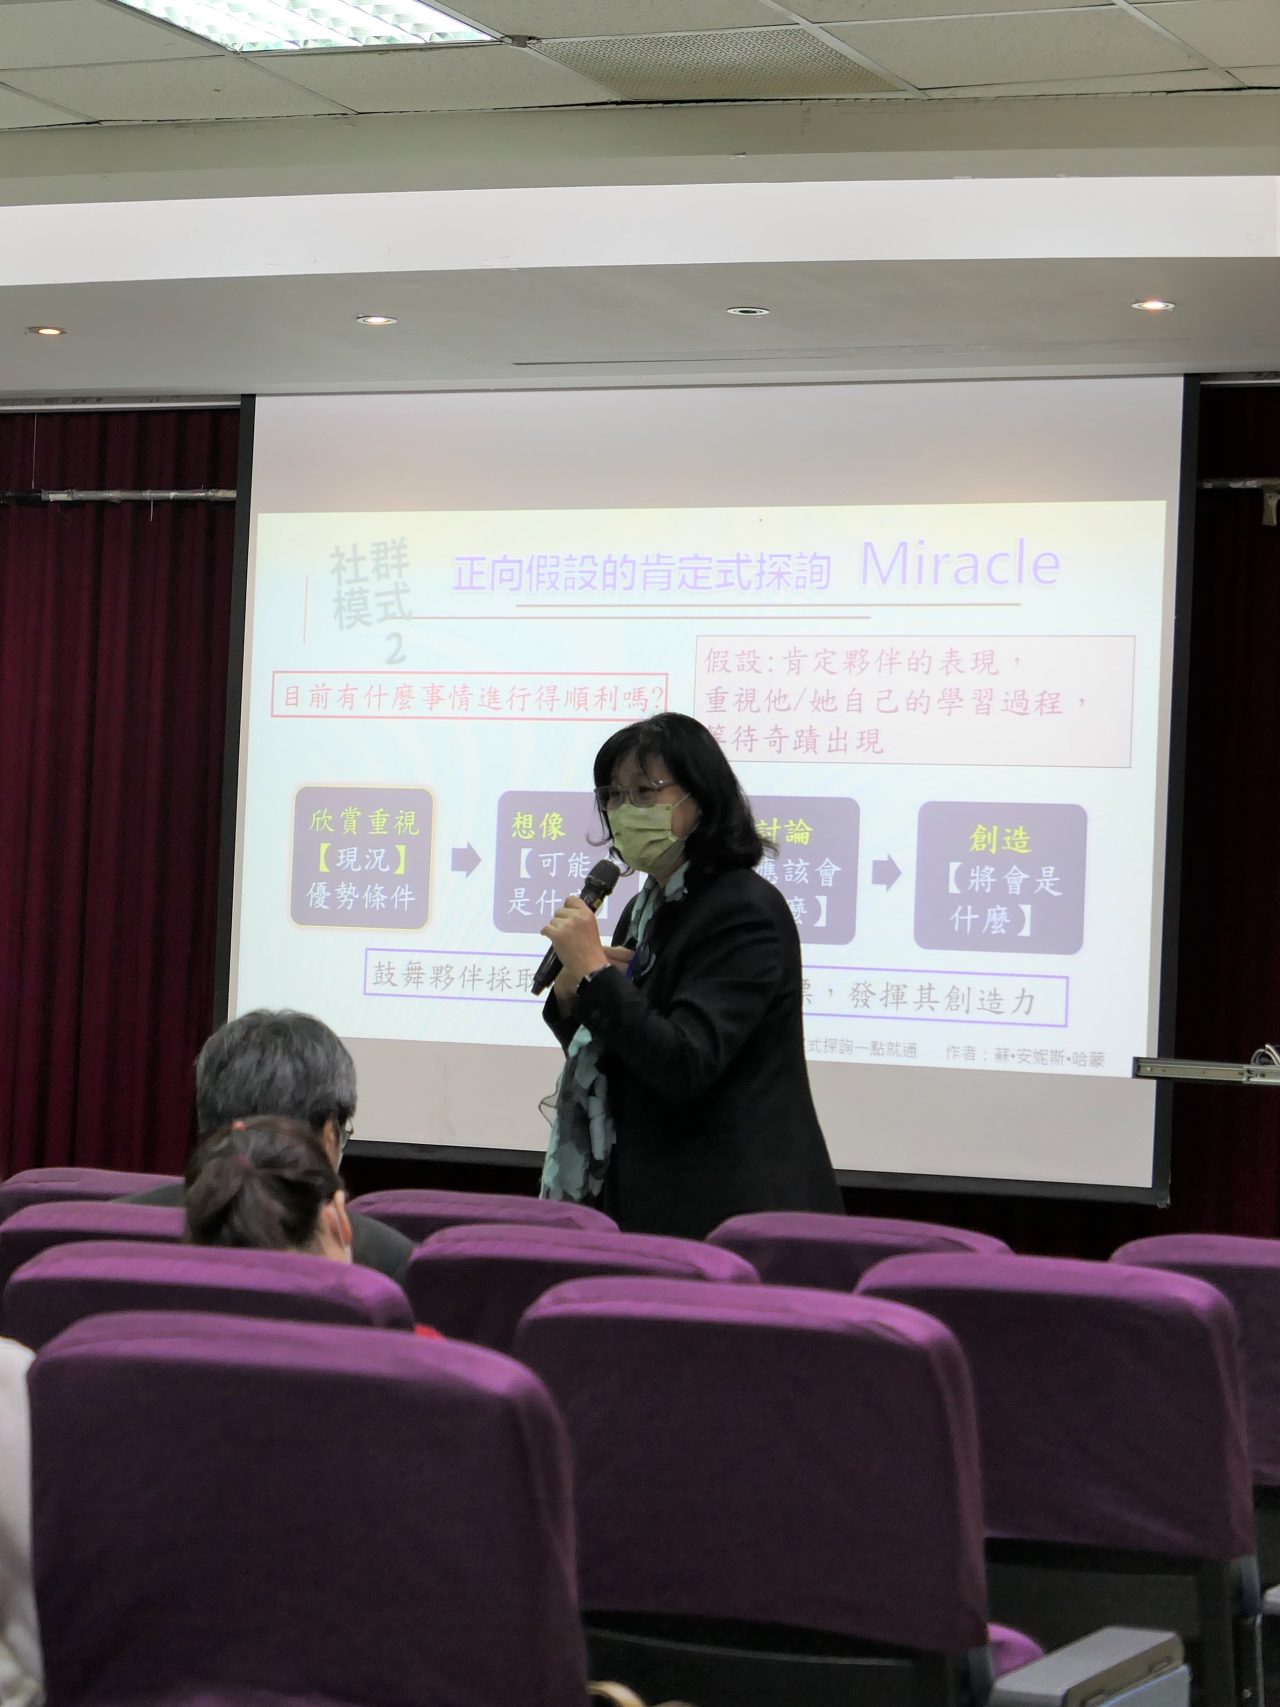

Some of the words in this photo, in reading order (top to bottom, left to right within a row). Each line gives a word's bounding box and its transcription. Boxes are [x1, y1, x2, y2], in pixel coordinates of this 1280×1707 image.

[330, 536, 410, 587] 社群
[452, 552, 831, 592] 正向假設的肯定式探詢
[862, 538, 1061, 586] Miracle
[333, 581, 412, 631] 模式
[385, 632, 407, 665] 2
[285, 683, 663, 712] 目前有什麼事情進行得順利嗎?
[309, 807, 419, 836] 欣賞重視
[512, 812, 566, 840] 想像
[755, 818, 813, 845] 討論
[969, 824, 1032, 854] 創造
[306, 881, 416, 912] 優勢條件
